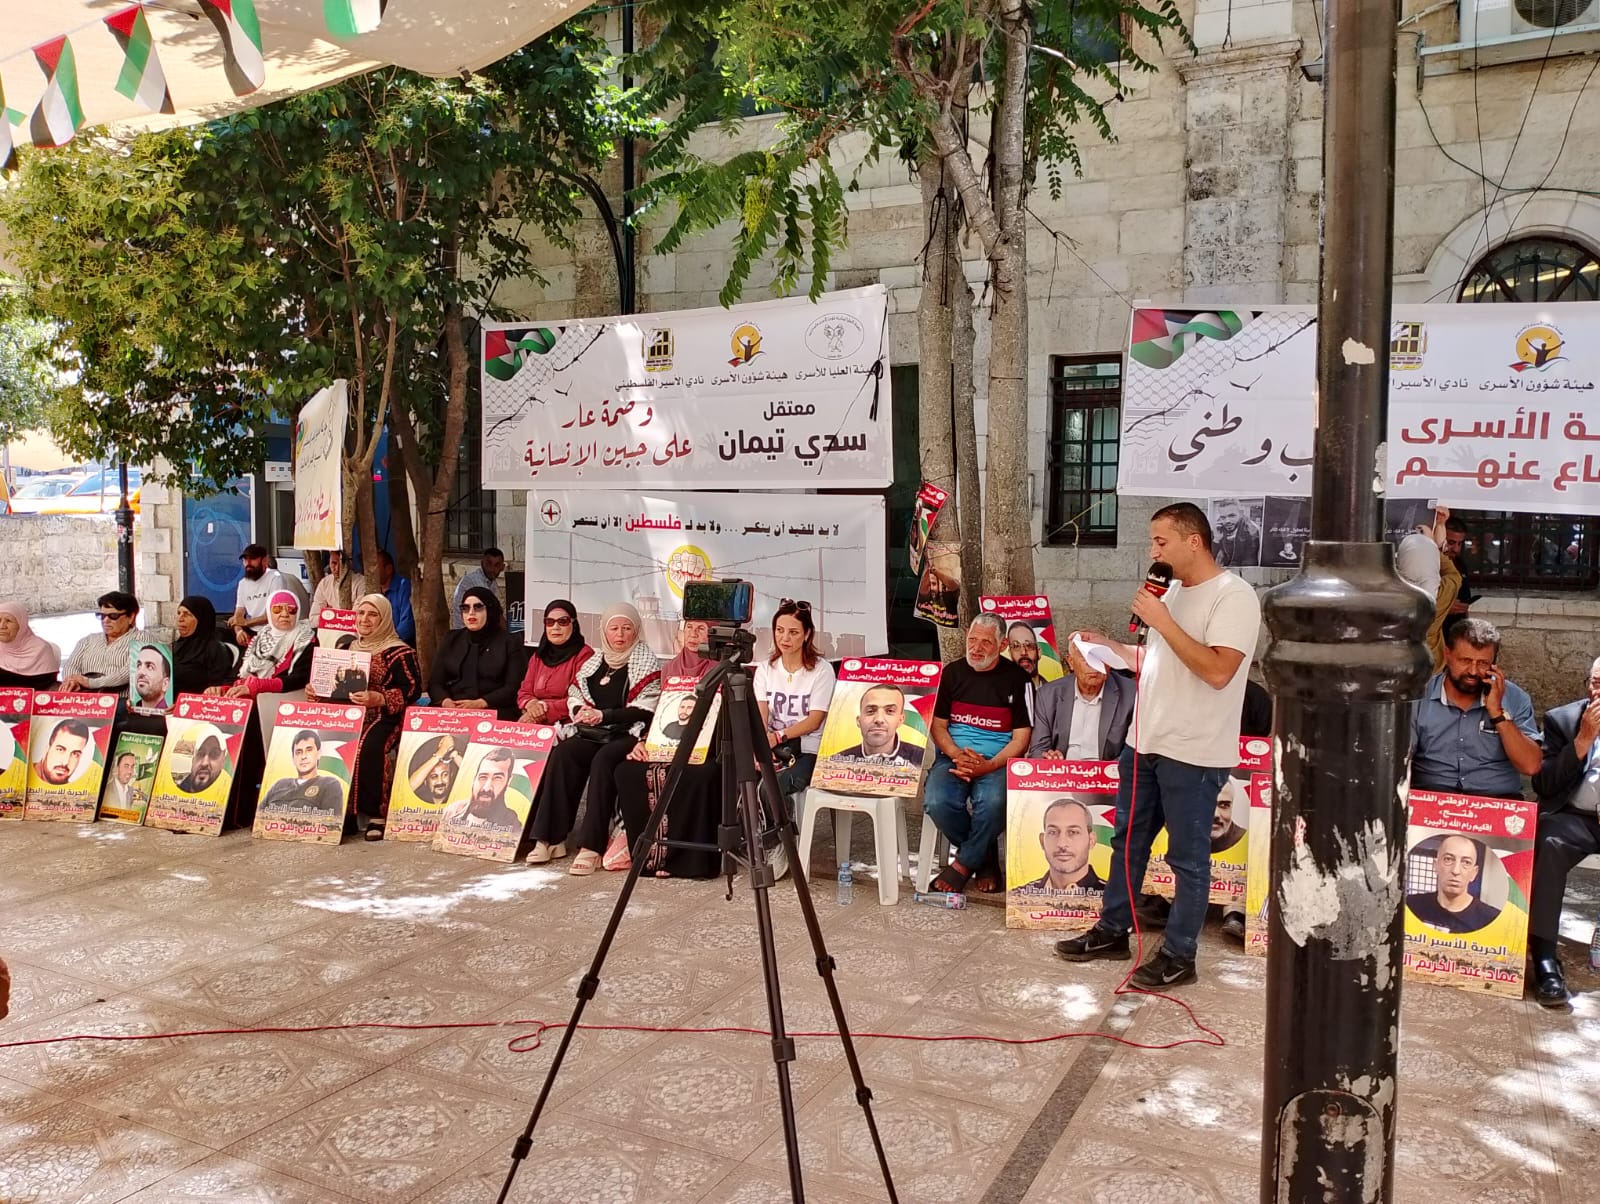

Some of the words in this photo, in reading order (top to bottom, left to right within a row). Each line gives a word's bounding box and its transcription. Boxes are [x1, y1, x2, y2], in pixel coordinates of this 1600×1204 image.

[711, 371, 740, 386] الأسرى
[741, 371, 765, 385] شؤون
[766, 370, 788, 382] هيئة
[829, 366, 849, 379] العليا
[614, 378, 658, 392] الفلسطيني
[685, 375, 704, 388] نادي
[1439, 376, 1469, 392] نادي
[1479, 375, 1524, 391] الأسرى
[1526, 377, 1560, 392] شؤون
[1562, 378, 1595, 392] هيئة
[561, 400, 596, 429] عار
[763, 400, 816, 421] معتقل
[1401, 406, 1551, 445] الأسرى
[652, 432, 692, 467] على
[718, 427, 785, 461] تيمان
[794, 433, 867, 467] سدي
[523, 439, 598, 477] الإنسانية
[602, 441, 648, 469] جبين
[1395, 451, 1541, 488] عنهم
[624, 512, 682, 533] فلسطين
[864, 662, 891, 673] العليا
[892, 663, 918, 674] الهيئة
[297, 705, 320, 717] العليا
[321, 706, 344, 718] الهيئة
[954, 713, 993, 727] adidas
[493, 725, 515, 735] العليا
[1036, 763, 1069, 777] العليا
[1070, 765, 1102, 778] الهيئة
[1050, 779, 1076, 789] الأسرى
[1437, 796, 1469, 807] الوطني
[1470, 801, 1503, 810] التحرير
[1503, 802, 1529, 813] حركة
[1423, 817, 1448, 828] والبيرة
[1448, 818, 1461, 828] الله
[1461, 822, 1473, 831] رام
[1430, 937, 1468, 950] للأسير
[1471, 942, 1507, 955] الحرية
[1416, 960, 1456, 973] الكريم
[1459, 964, 1482, 978] عبد
[1486, 967, 1519, 983] عماد
